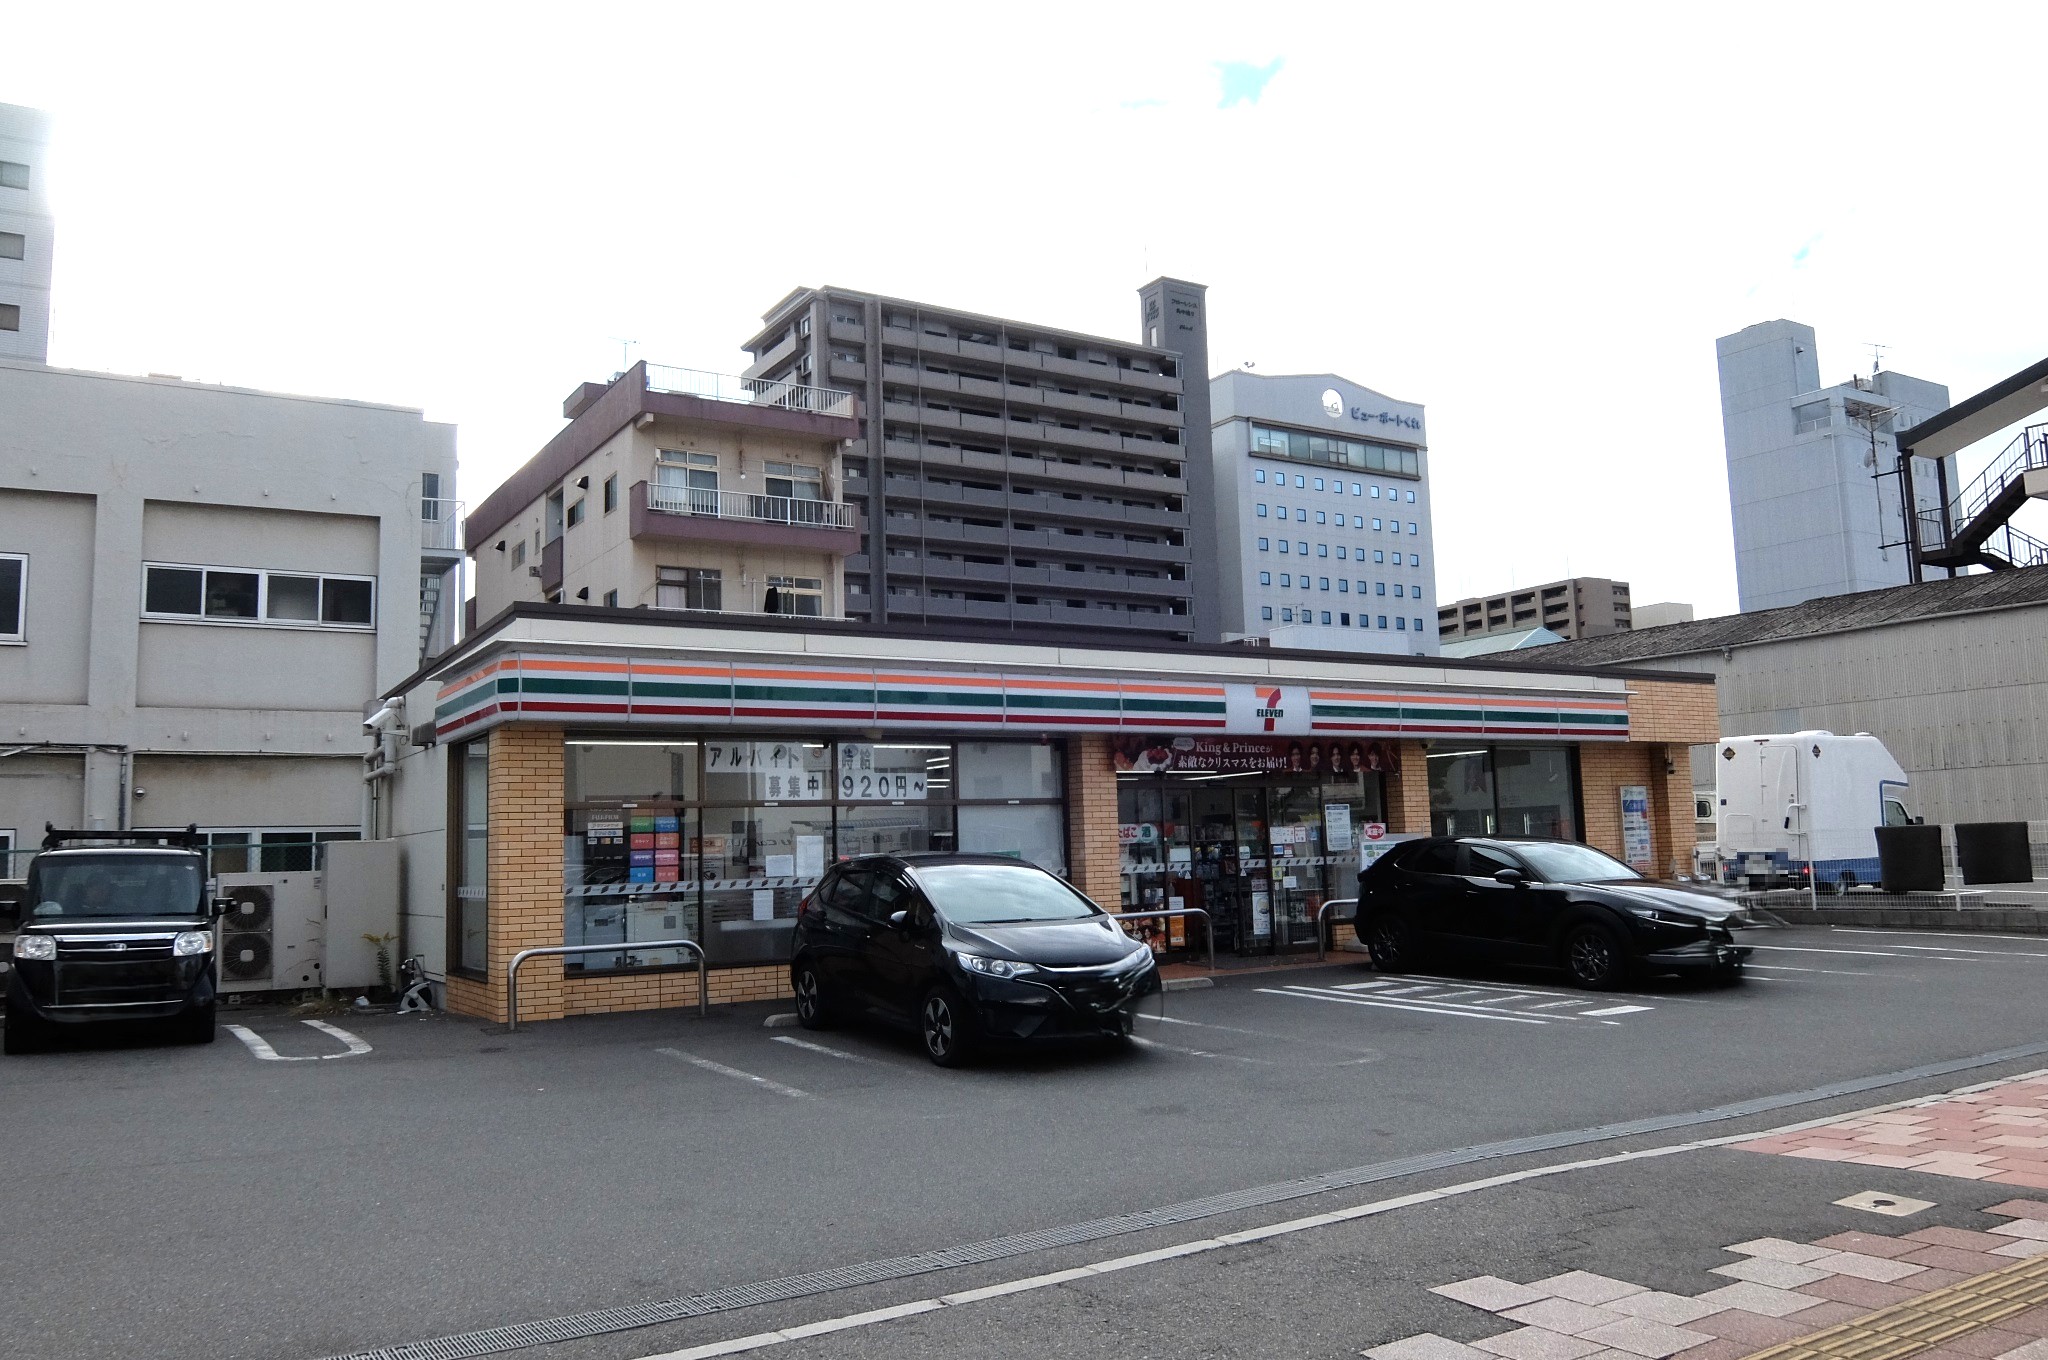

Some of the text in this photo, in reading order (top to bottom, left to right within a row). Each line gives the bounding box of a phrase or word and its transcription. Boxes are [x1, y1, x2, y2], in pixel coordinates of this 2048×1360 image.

[1195, 742, 1222, 755] King
[1223, 742, 1231, 753] &
[768, 775, 820, 798] 募集中
[1141, 826, 1151, 838] 酒
